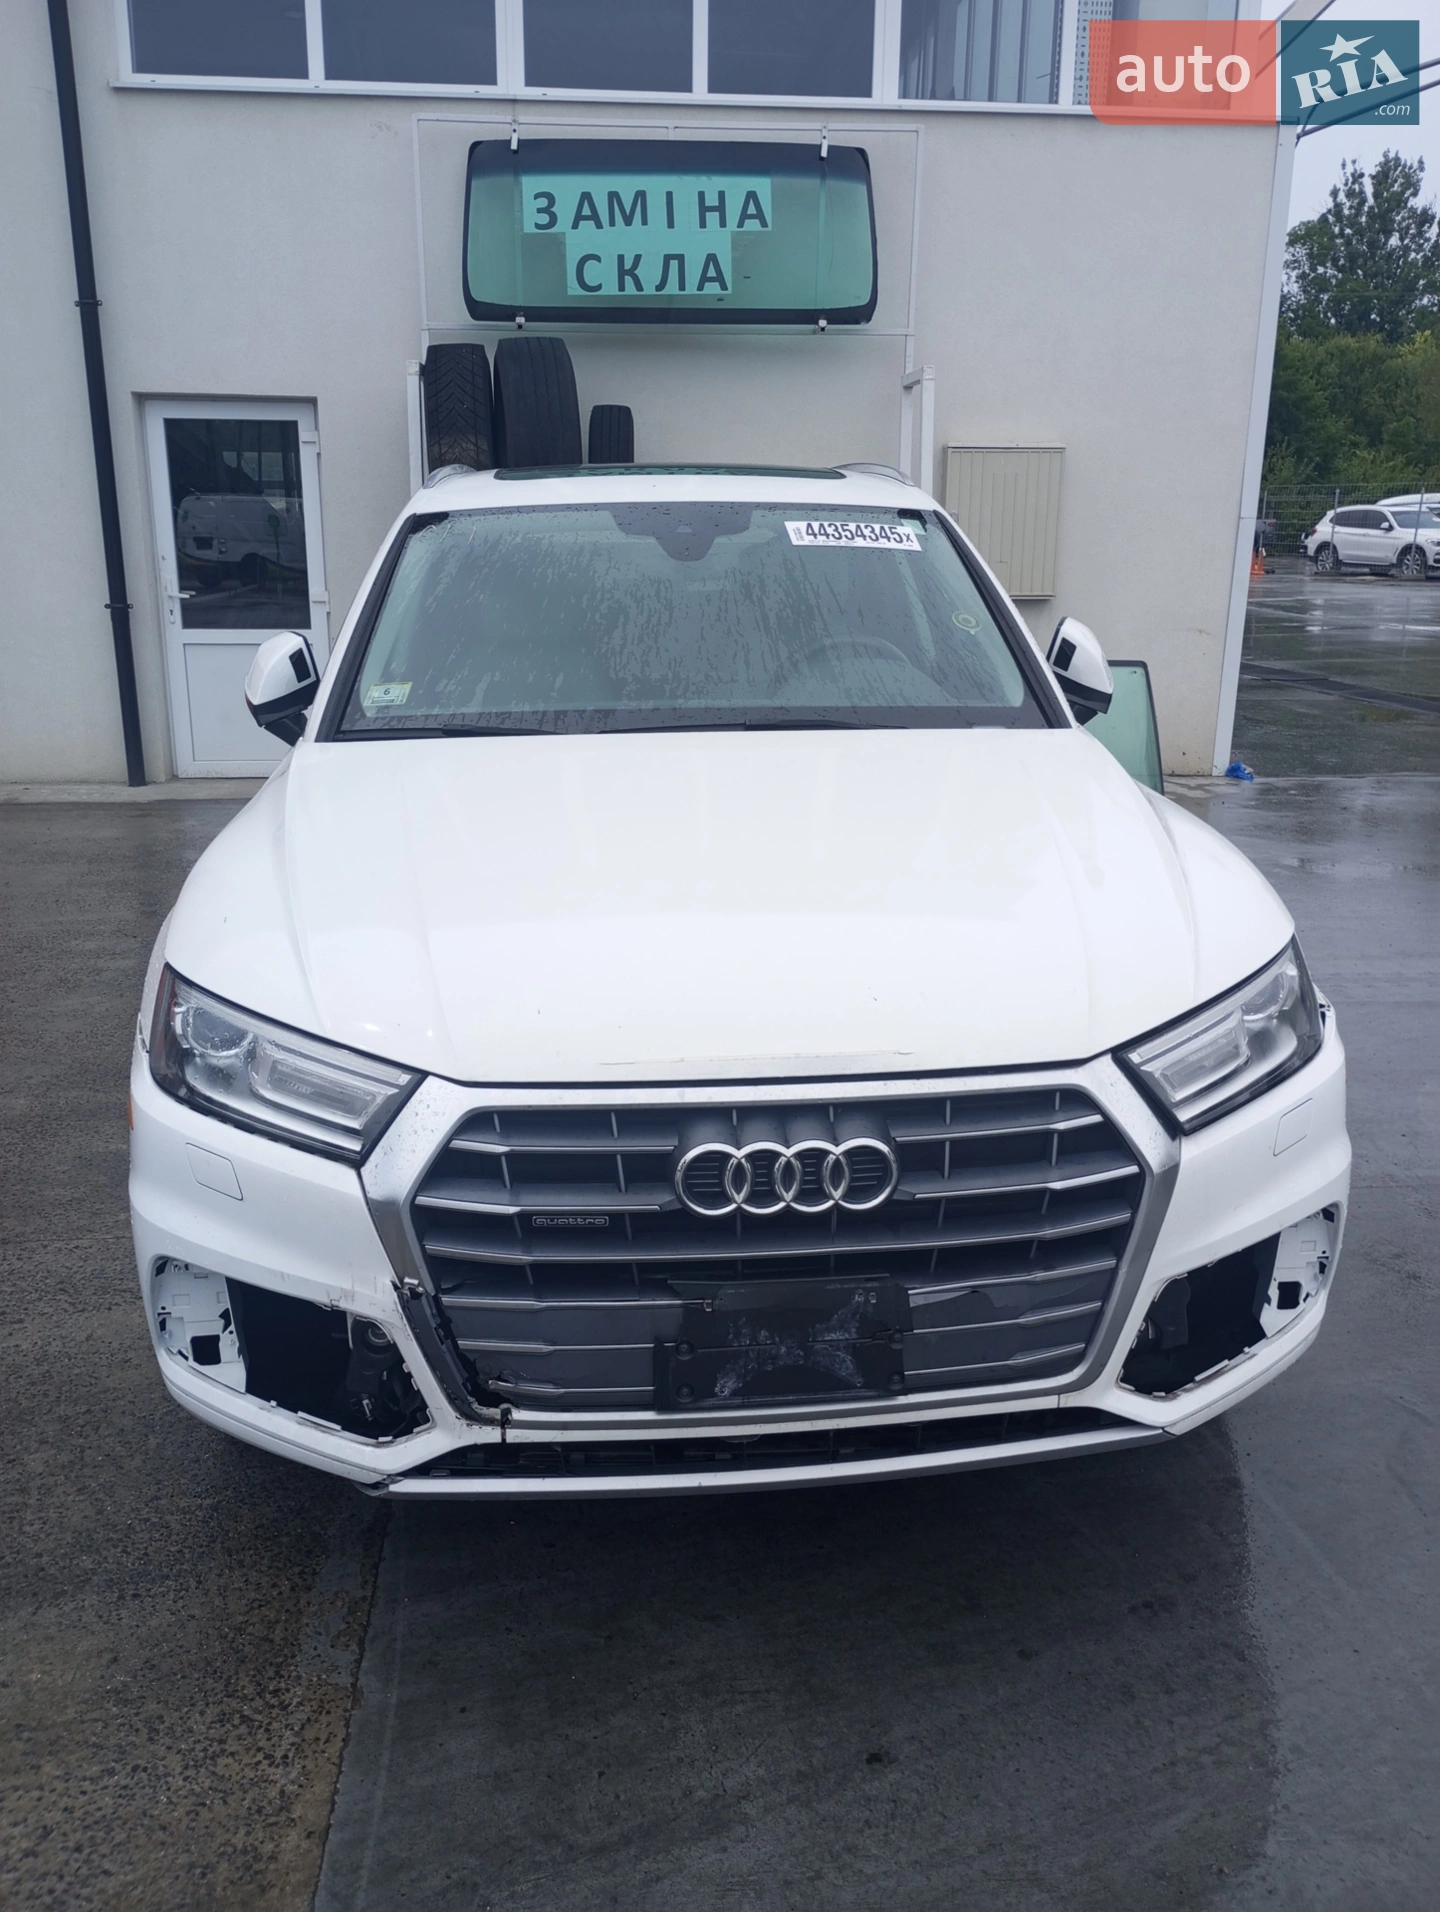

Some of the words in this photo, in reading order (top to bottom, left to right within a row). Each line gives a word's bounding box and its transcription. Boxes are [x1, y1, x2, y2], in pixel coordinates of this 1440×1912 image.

[532, 189, 770, 231] ЗАМІНА
[574, 252, 729, 294] СКЛА
[383, 687, 391, 696] 6
[536, 1217, 606, 1226] quattro
